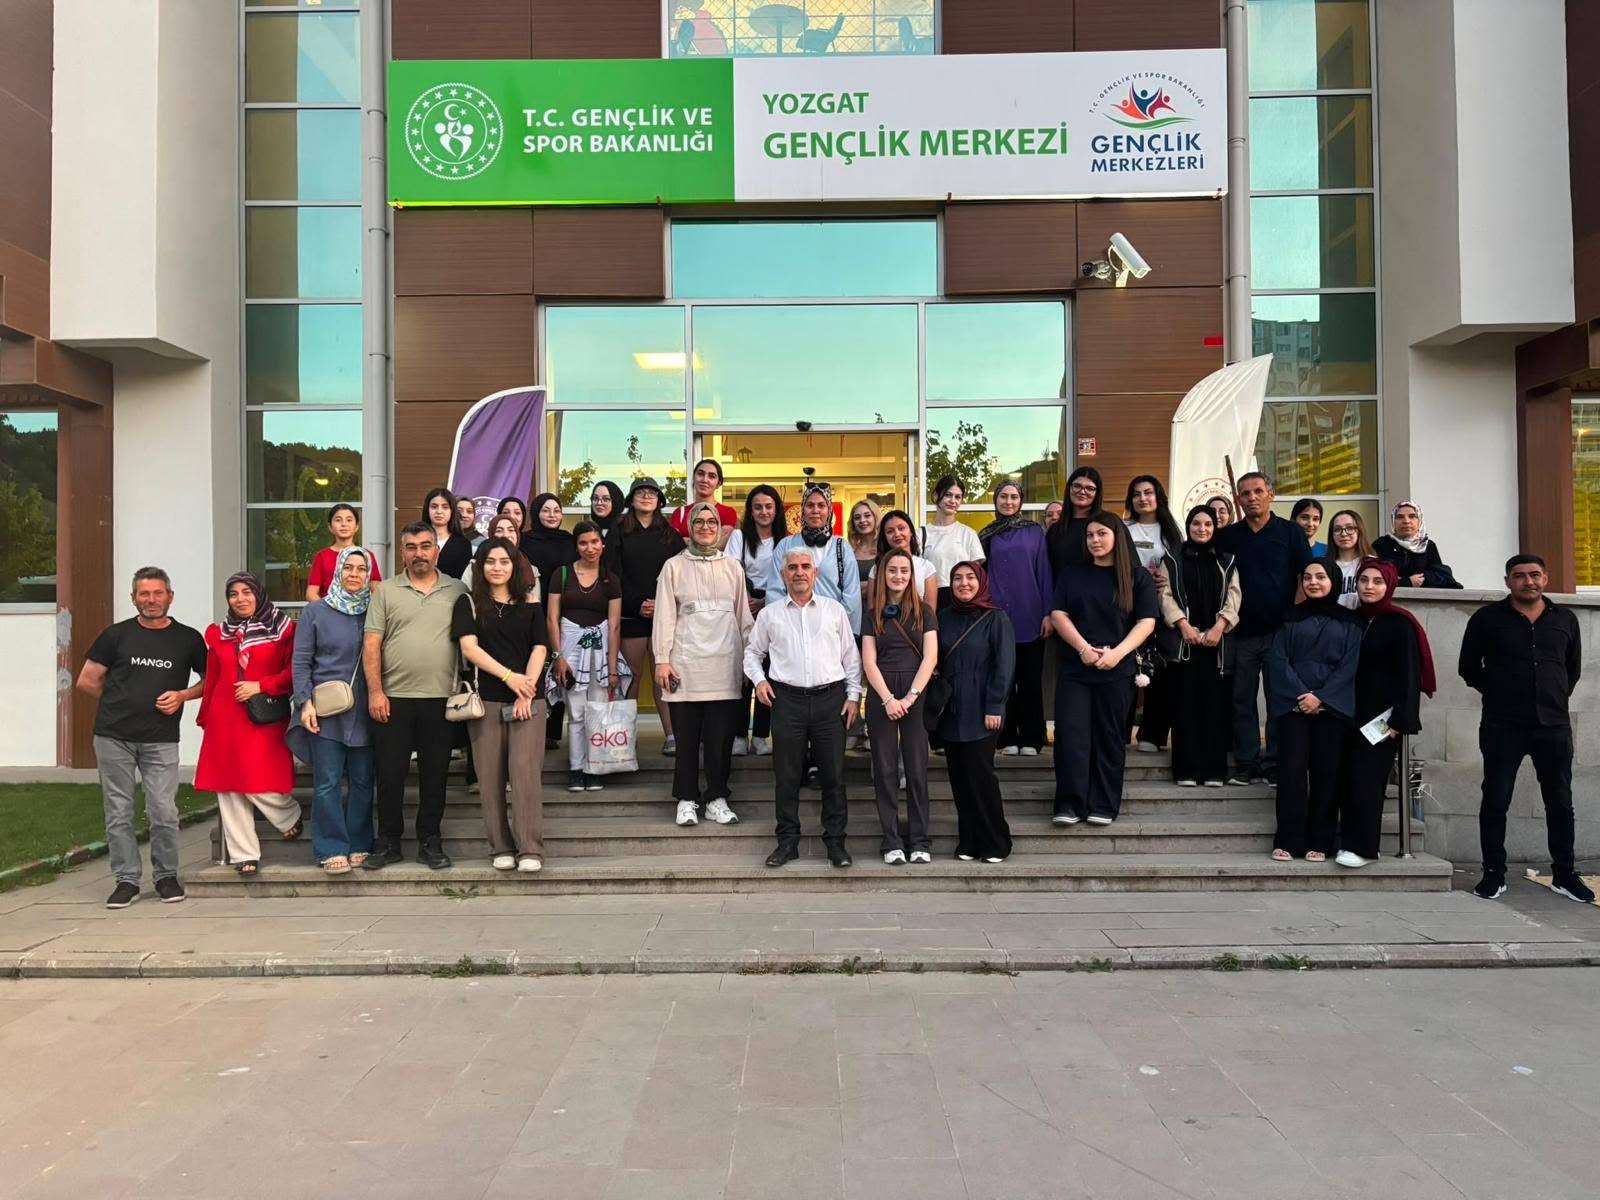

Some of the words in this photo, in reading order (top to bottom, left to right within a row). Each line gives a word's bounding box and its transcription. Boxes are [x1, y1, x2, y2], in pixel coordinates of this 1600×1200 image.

[763, 92, 869, 114] YOZGAT
[523, 109, 564, 126] T.C.
[573, 105, 675, 131] GENÇLİK
[684, 108, 713, 125] VE
[523, 135, 583, 153] SPOR
[590, 130, 713, 152] BAKANLIĞI
[763, 124, 910, 165] GENÇLİK
[919, 121, 1067, 155] MERKEZİ
[1091, 132, 1201, 154] GENÇLİK
[1091, 154, 1204, 172] MERKEZLERİ
[131, 657, 172, 669] MANGO
[591, 729, 628, 748] eka
